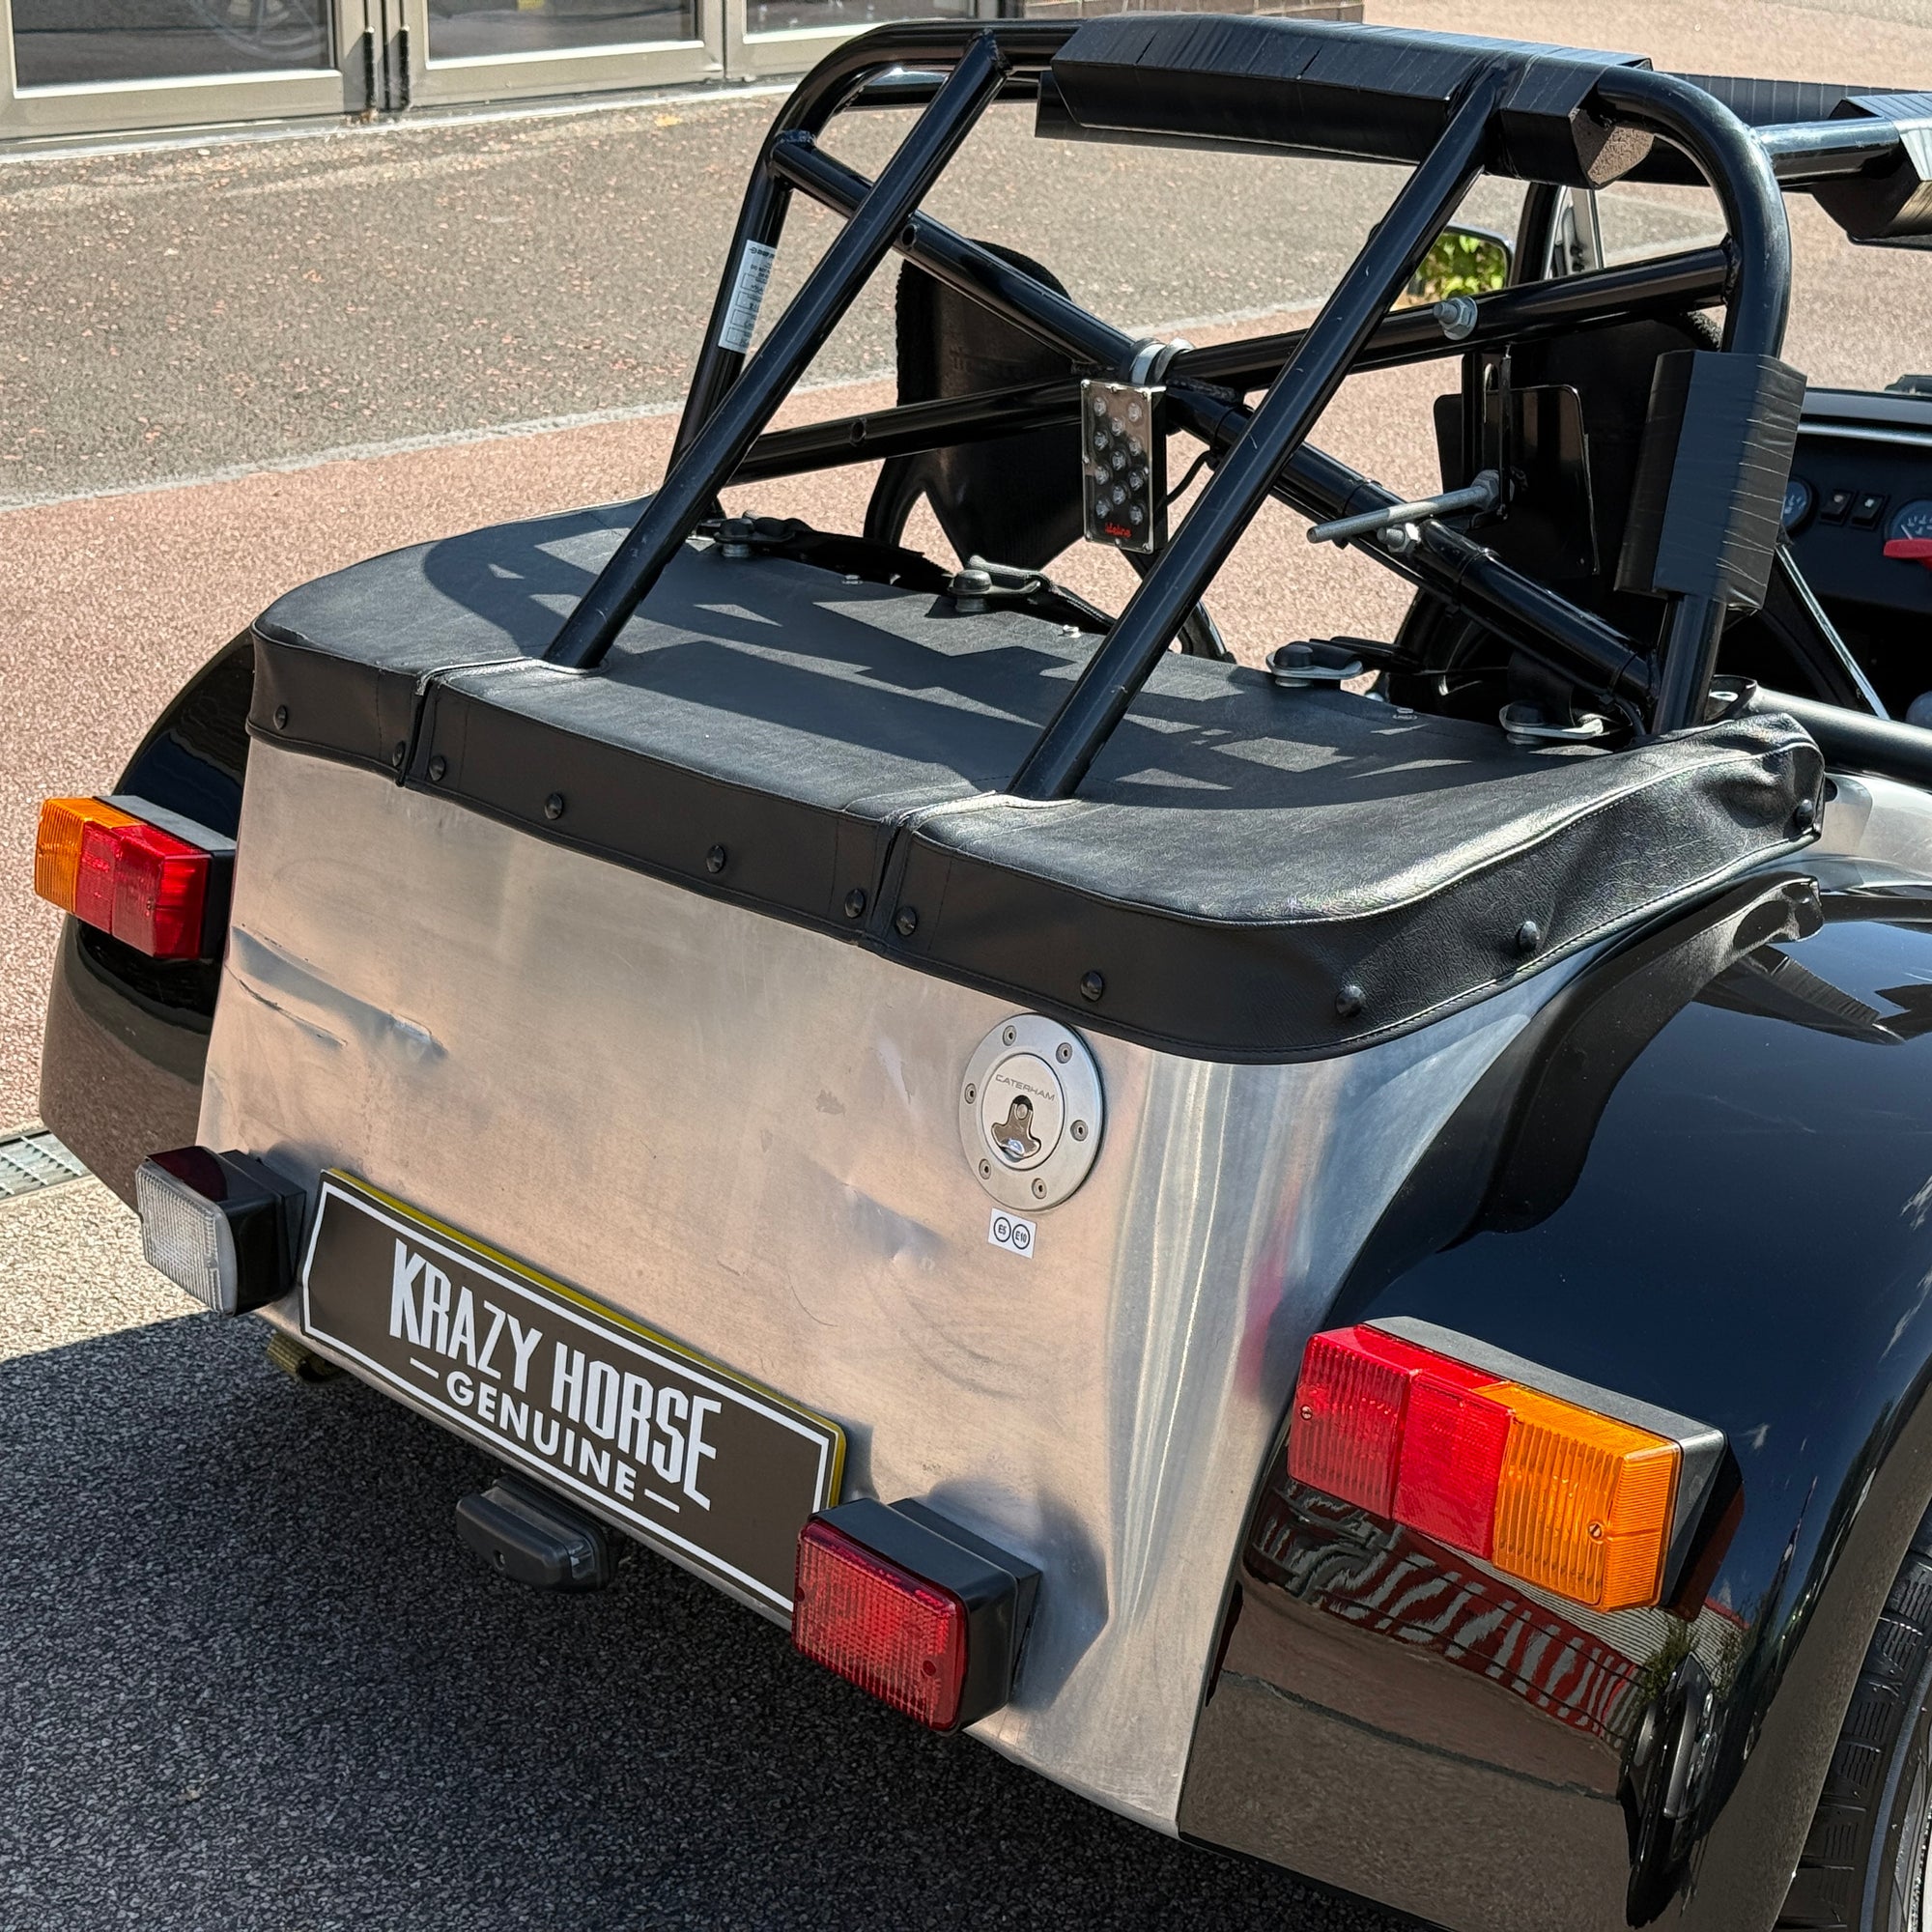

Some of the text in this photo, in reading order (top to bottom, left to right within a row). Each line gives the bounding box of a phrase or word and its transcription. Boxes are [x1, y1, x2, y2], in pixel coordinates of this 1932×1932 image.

[995, 1073, 1056, 1101] CATERHAM
[1015, 1230, 1028, 1243] E10
[388, 1237, 723, 1512] KRAZY HORSE
[445, 1370, 638, 1502] GENUINE
